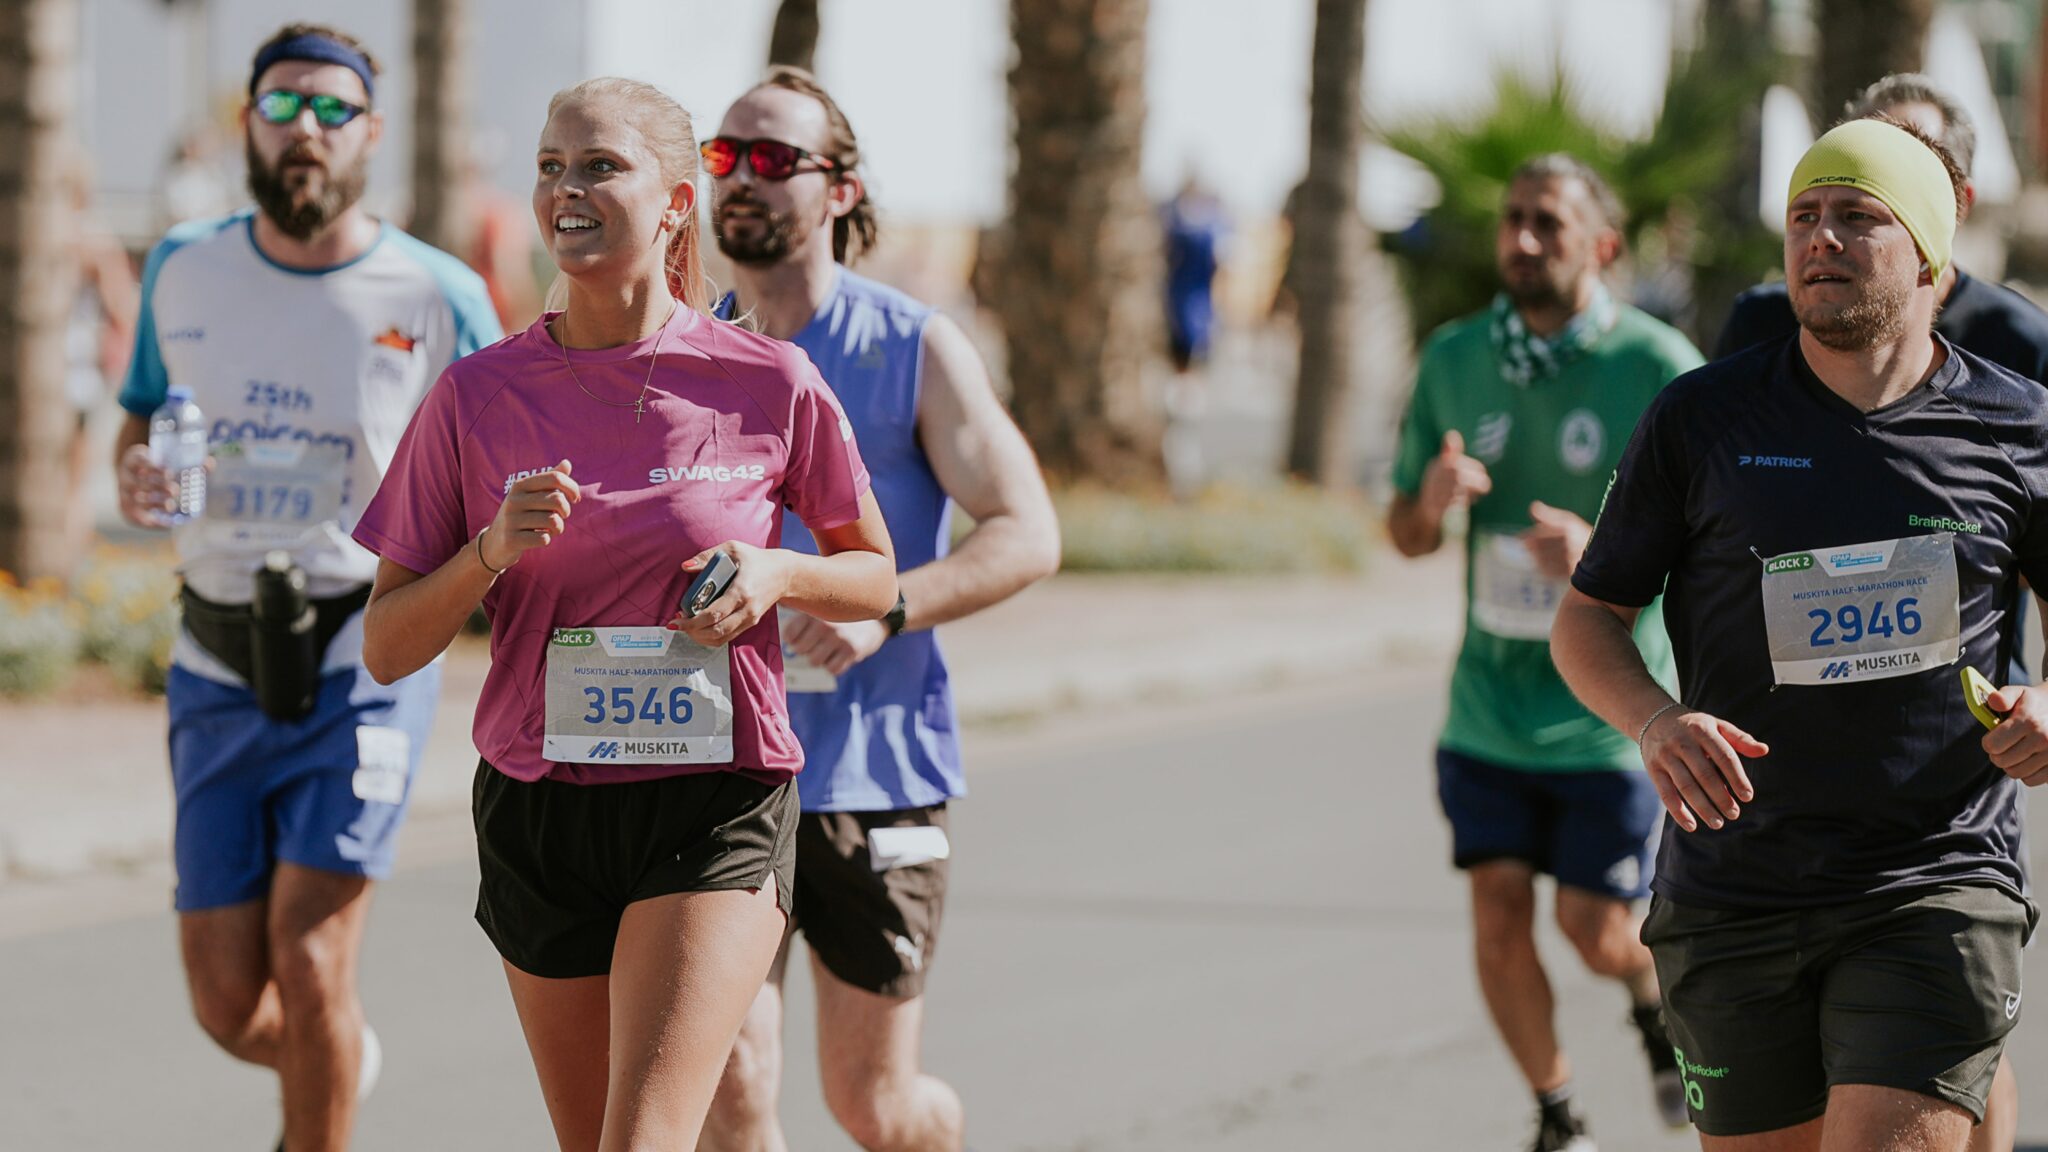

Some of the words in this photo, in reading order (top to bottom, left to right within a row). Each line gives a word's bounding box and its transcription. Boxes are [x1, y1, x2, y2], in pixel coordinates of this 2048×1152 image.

[1807, 176, 1856, 186] ACCAPI
[247, 381, 313, 410] 25th
[1755, 456, 1812, 468] PATRICK
[649, 464, 765, 484] SWAG42
[228, 485, 314, 520] 3179
[1908, 514, 1982, 534] BrainRocket
[1768, 558, 1800, 572] BLOCK
[1803, 557, 1810, 567] 2
[1793, 589, 1830, 601] MUSKITA
[1832, 581, 1905, 596] HALF-MARATHON
[1906, 577, 1928, 587] RACE
[1807, 598, 1922, 647] 2946
[553, 633, 582, 644] LOCK
[585, 634, 592, 643] 2
[1856, 652, 1921, 671] MUSKITA
[574, 667, 607, 676] MUSKITA
[609, 668, 680, 676] HALF-MARATHON
[583, 686, 693, 725] 3546
[625, 742, 689, 755] MUSKITA
